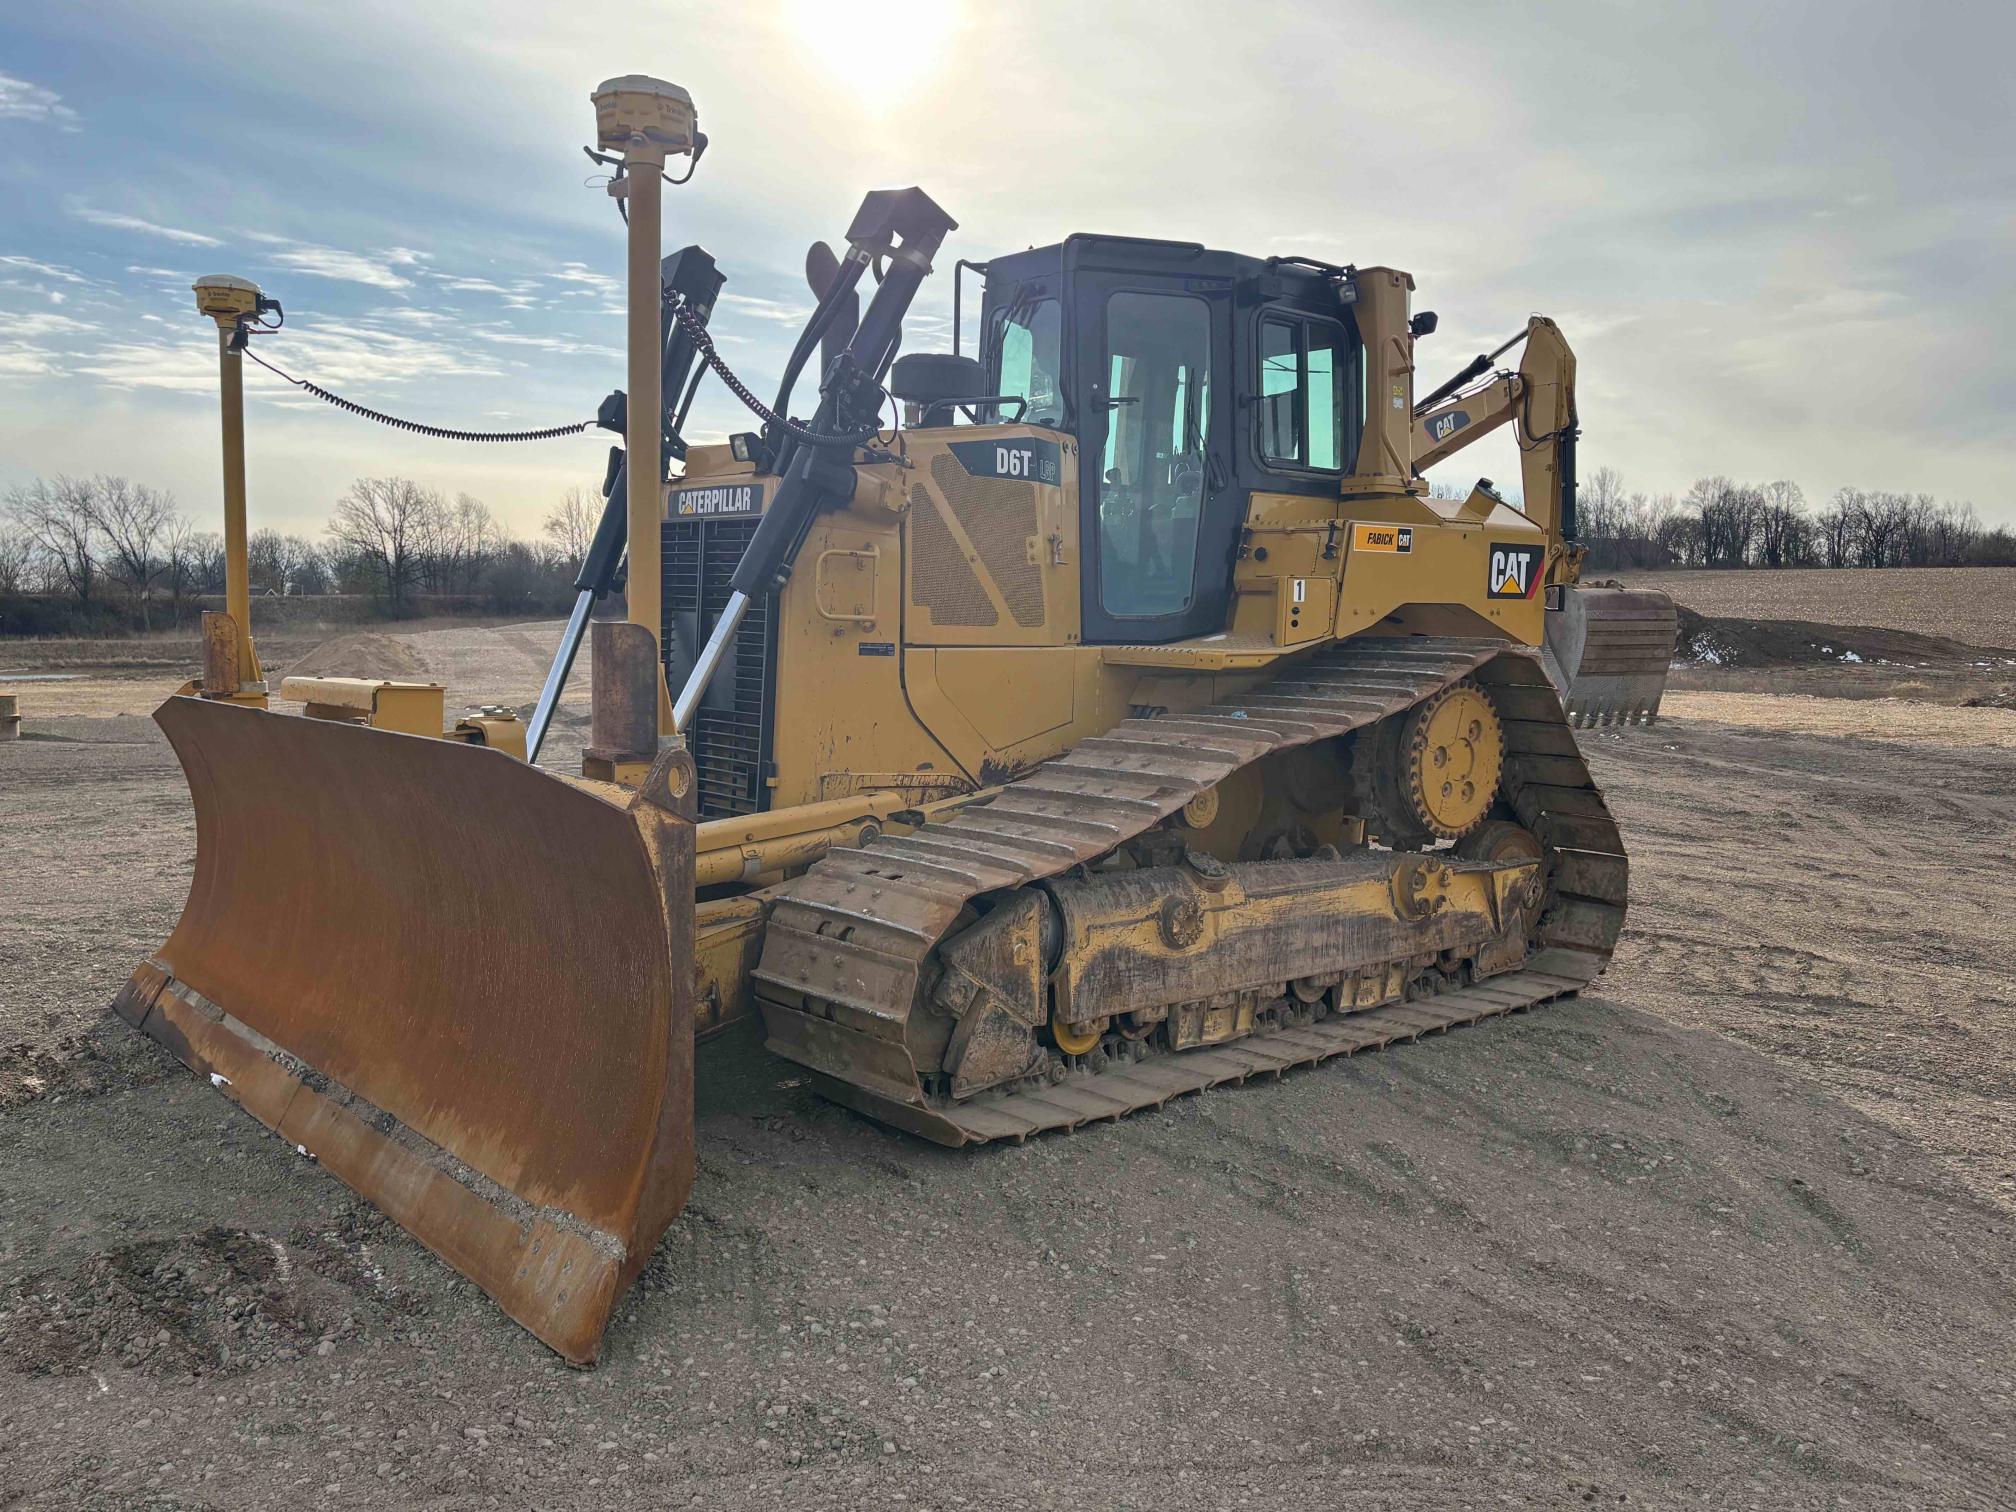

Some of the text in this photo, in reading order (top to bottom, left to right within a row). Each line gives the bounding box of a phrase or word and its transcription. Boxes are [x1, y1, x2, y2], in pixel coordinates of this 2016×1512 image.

[1437, 413, 1454, 438] CAT
[996, 447, 1032, 477] D6T
[679, 487, 751, 514] CATERPILLAR
[1367, 532, 1410, 546] FABICK CAT
[1491, 551, 1530, 593] CAT
[1296, 580, 1302, 601] 1
